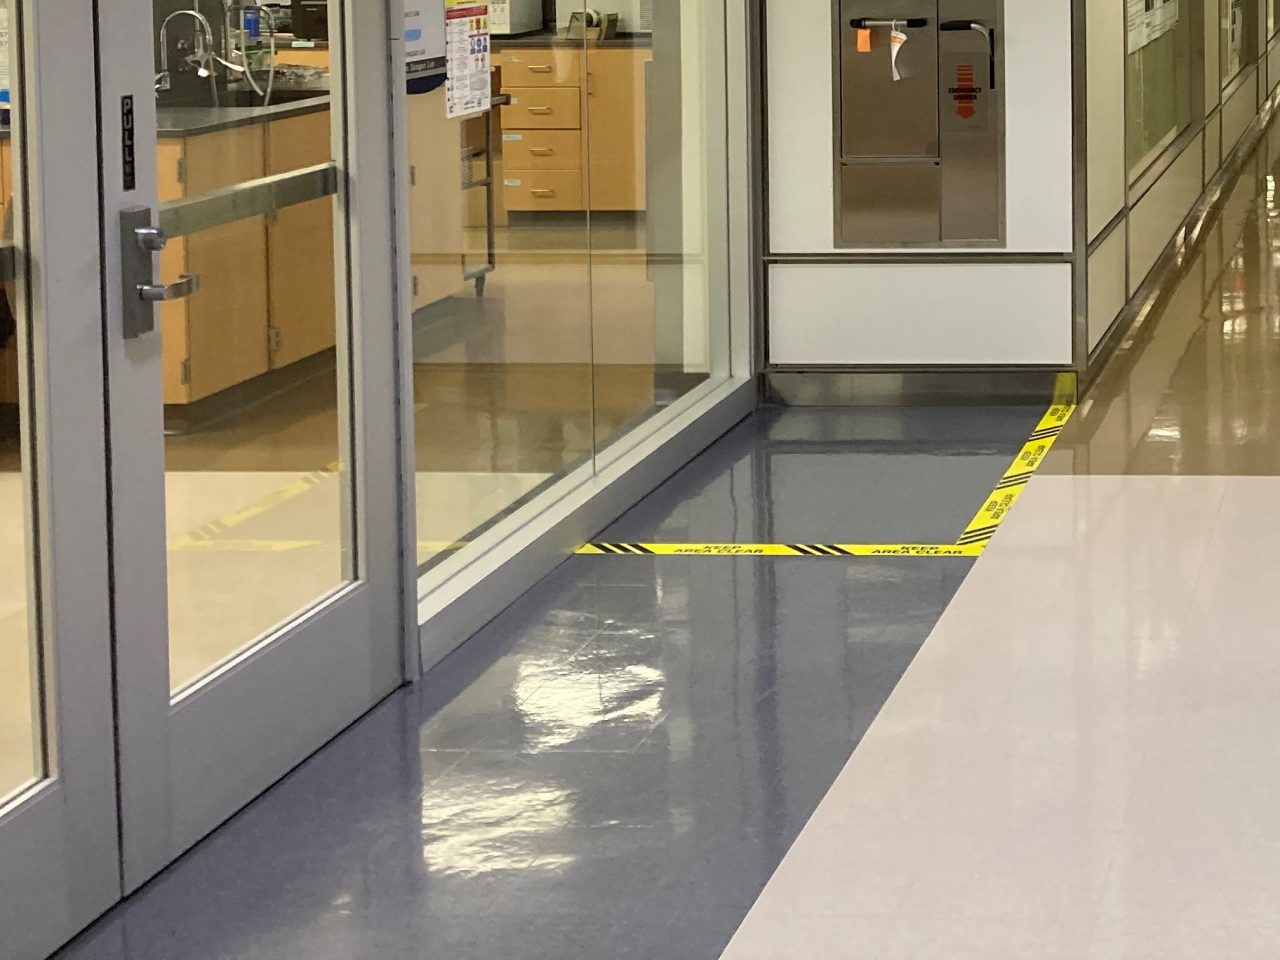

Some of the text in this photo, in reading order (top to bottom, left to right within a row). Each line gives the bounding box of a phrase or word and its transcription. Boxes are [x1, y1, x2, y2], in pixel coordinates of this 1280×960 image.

[123, 98, 132, 161] PULL
[985, 500, 998, 512] KEEP
[990, 507, 1004, 519] AREA
